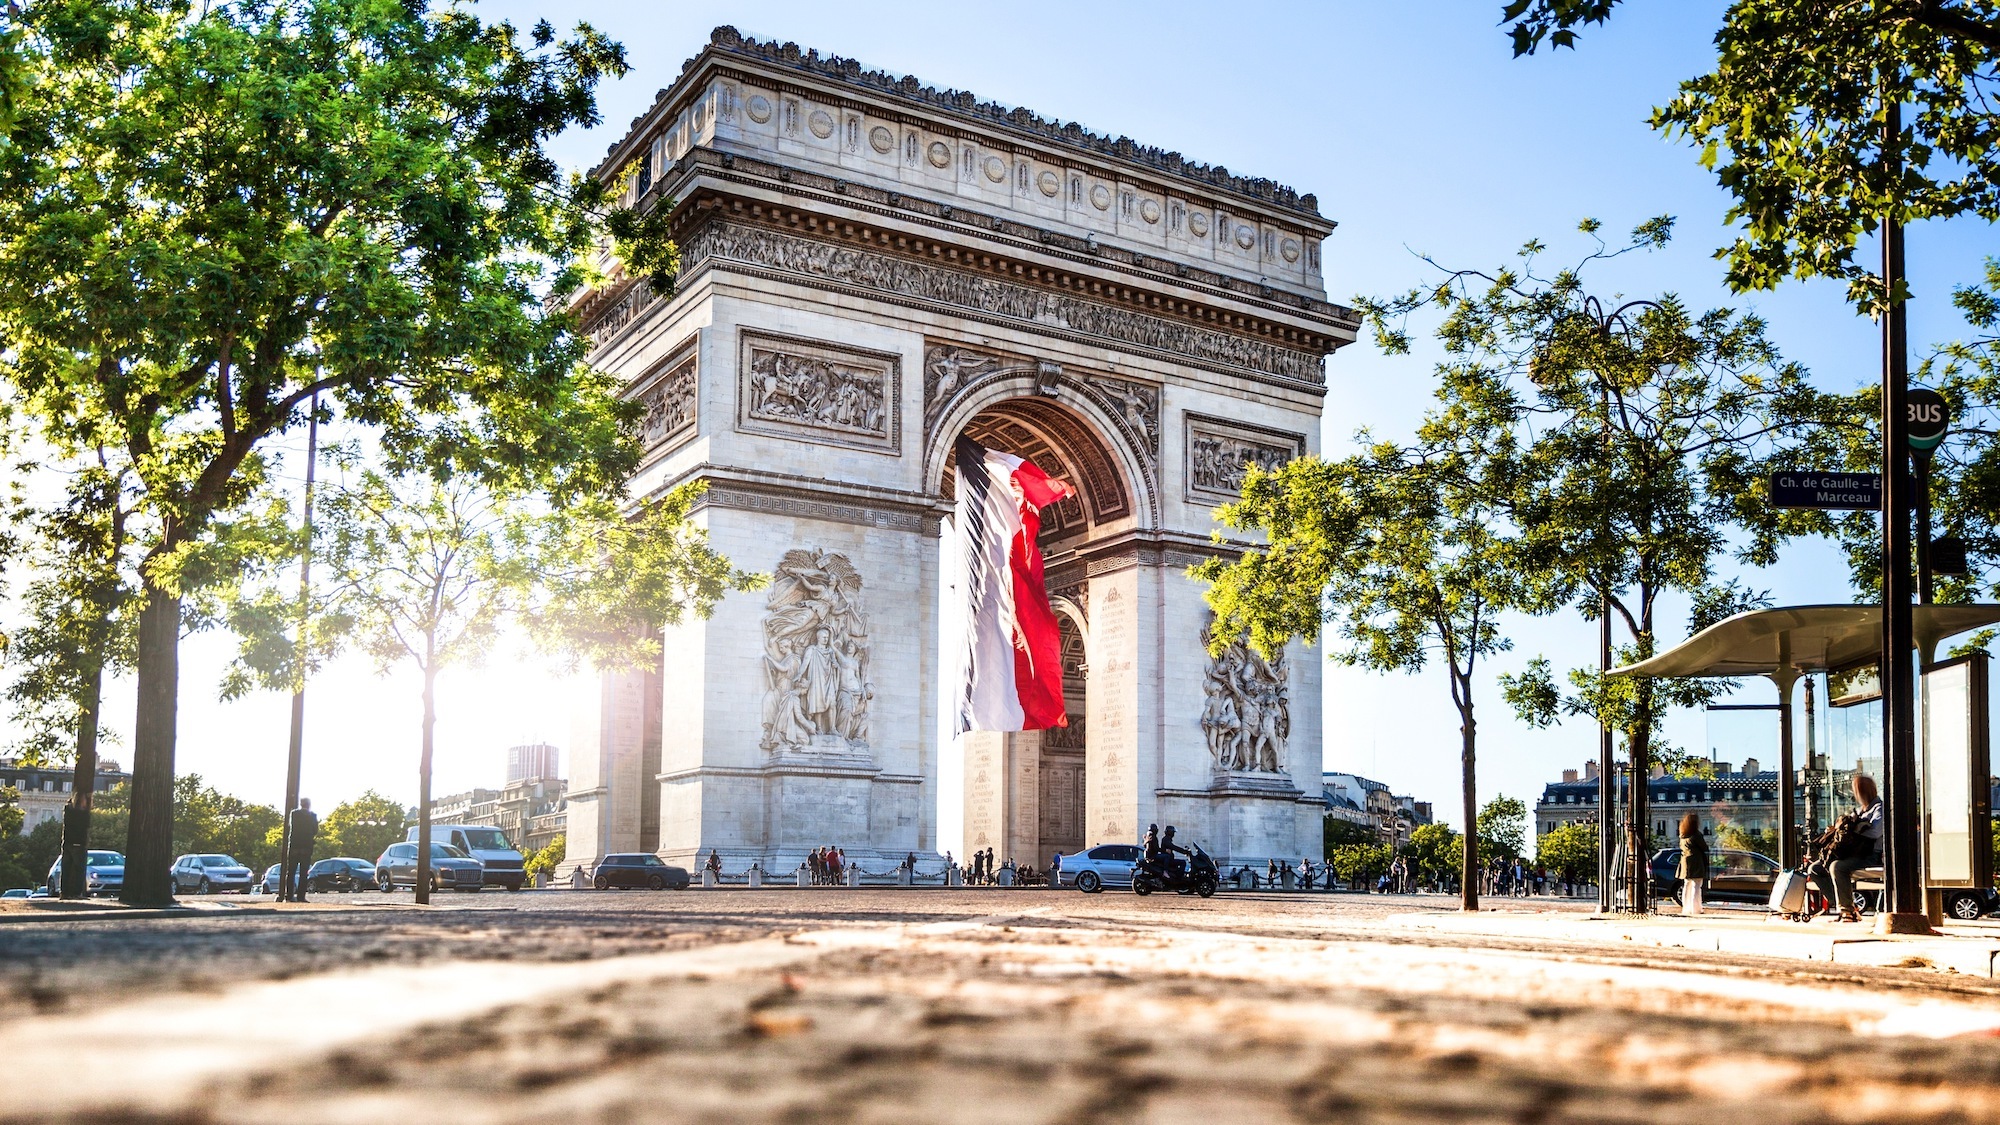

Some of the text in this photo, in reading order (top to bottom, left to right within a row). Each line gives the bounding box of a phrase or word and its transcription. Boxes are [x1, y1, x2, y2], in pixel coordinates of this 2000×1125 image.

[1907, 403, 1942, 422] BUS
[1779, 477, 1799, 488] Ch.
[1802, 477, 1817, 488] de
[1821, 477, 1859, 489] Gaulle
[1816, 491, 1871, 503] Marceau
